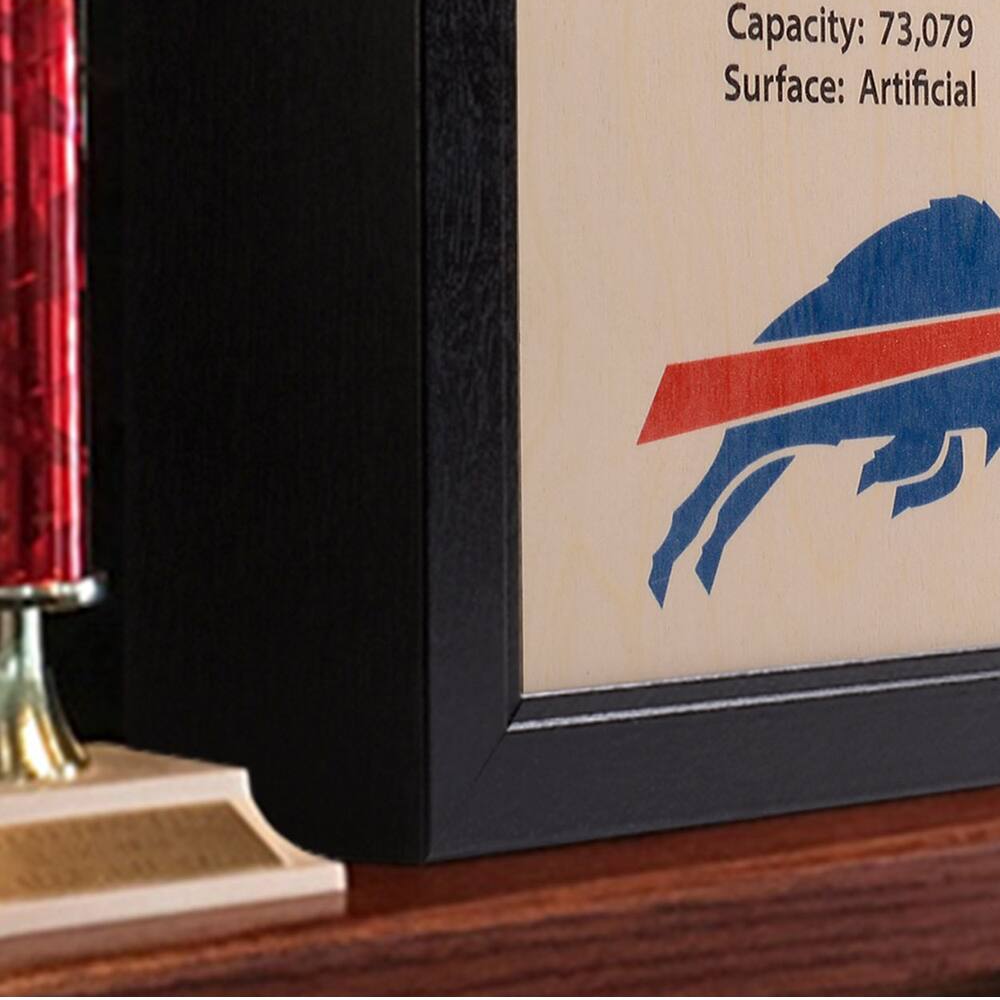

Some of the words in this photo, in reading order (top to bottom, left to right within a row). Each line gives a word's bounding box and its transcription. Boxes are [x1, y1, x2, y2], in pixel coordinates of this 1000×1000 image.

[728, 2, 863, 54] Capacity:
[880, 11, 973, 52] 73,079
[725, 64, 844, 104] Surface:
[859, 68, 976, 107] Artificial
